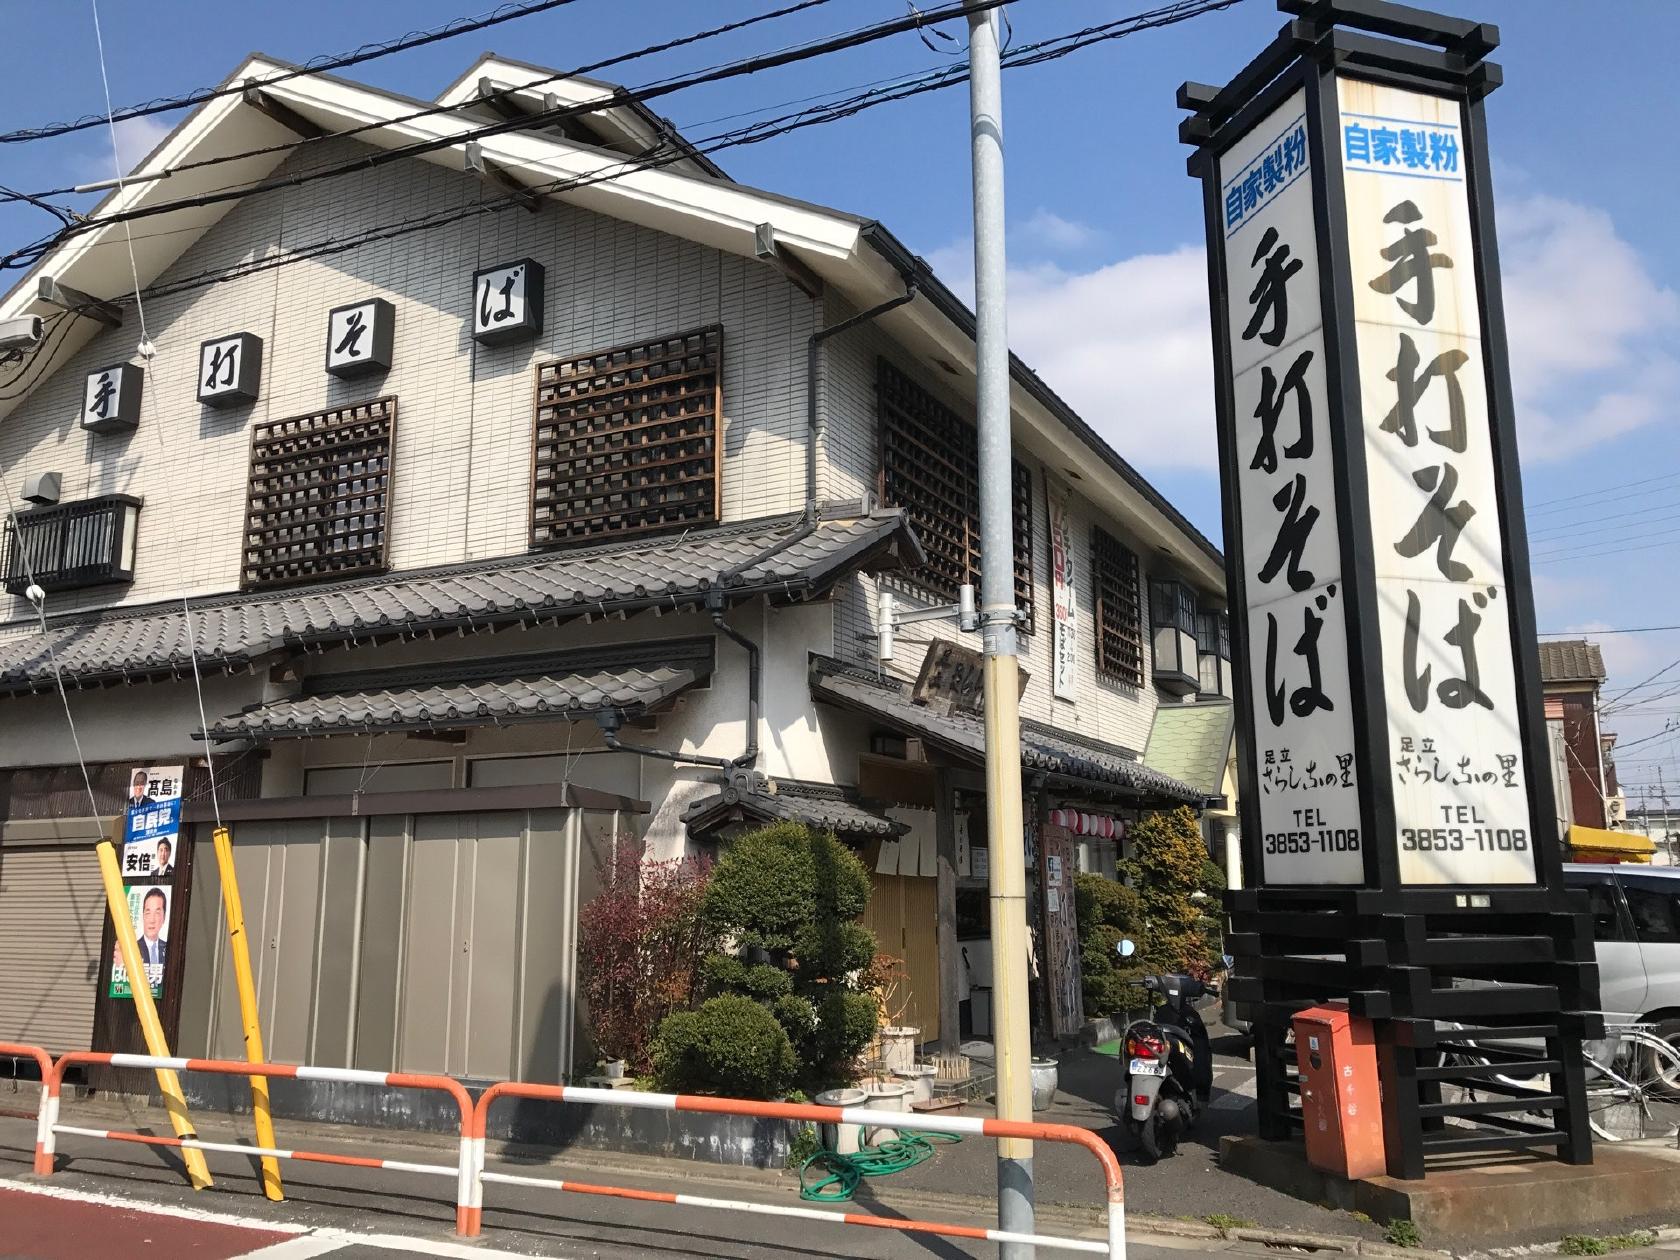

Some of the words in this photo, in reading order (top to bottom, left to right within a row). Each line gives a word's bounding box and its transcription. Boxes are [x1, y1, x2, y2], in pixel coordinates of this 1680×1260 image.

[1344, 123, 1459, 173] 自家製粉
[1225, 124, 1307, 230] 自家製粉
[1368, 199, 1498, 714] 手打そば
[1241, 226, 1338, 728] 手打そば
[1265, 747, 1292, 765] 足立
[1400, 736, 1437, 754] 足立
[132, 808, 172, 832] 自民党
[1292, 808, 1327, 828] TEL
[1440, 805, 1485, 824] TEL
[1265, 829, 1360, 855] 3853-1108
[1401, 828, 1528, 852] 3853-1108
[126, 853, 151, 872] 安倍
